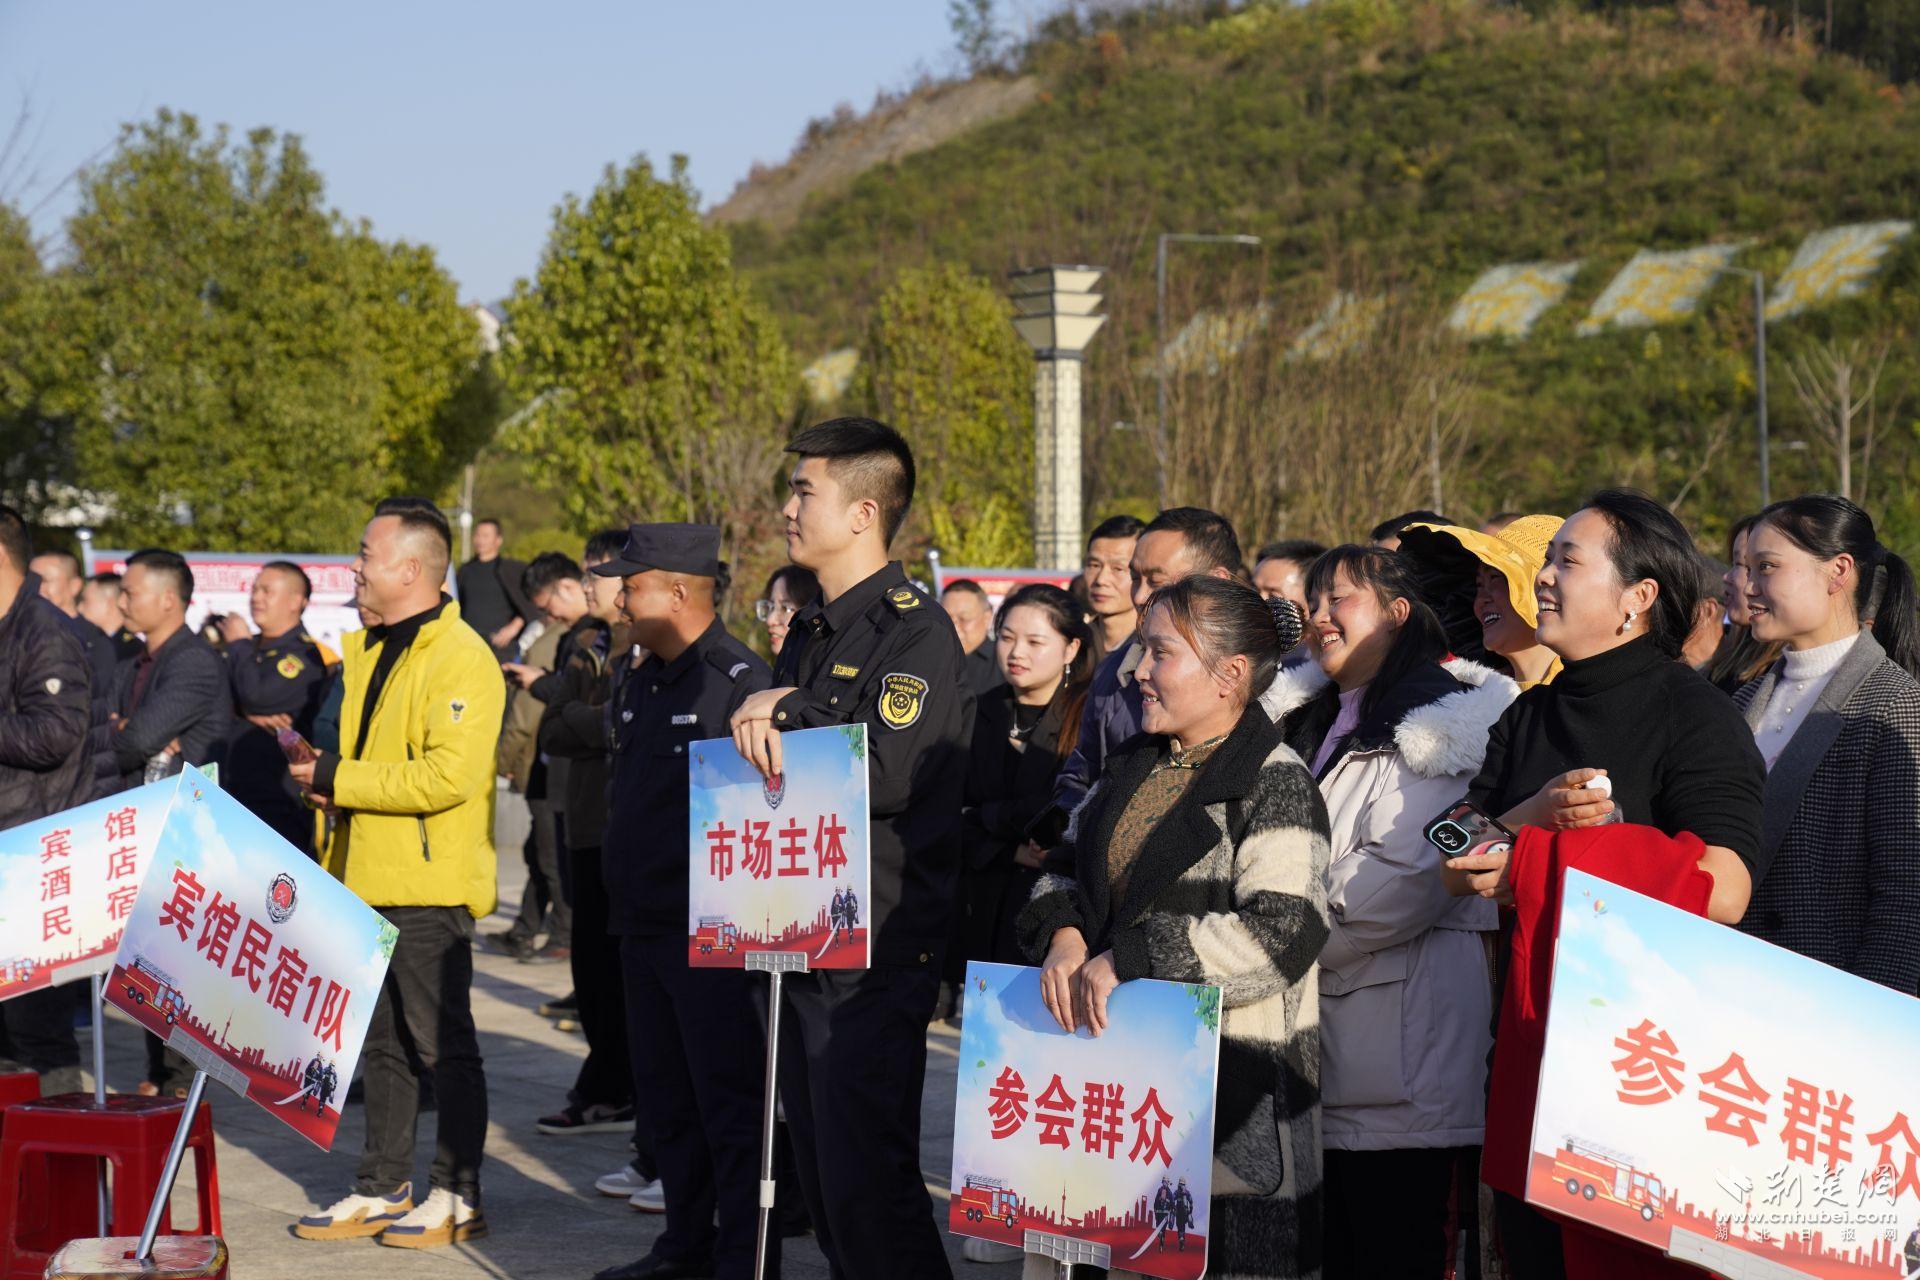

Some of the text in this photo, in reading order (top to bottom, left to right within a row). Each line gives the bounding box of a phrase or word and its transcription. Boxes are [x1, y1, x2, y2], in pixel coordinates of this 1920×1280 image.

[706, 813, 848, 882] 市场主体
[158, 867, 352, 1052] 宾馆民宿1队
[987, 1065, 1175, 1168] 参会群众
[1611, 1018, 1920, 1201] 参会群众
